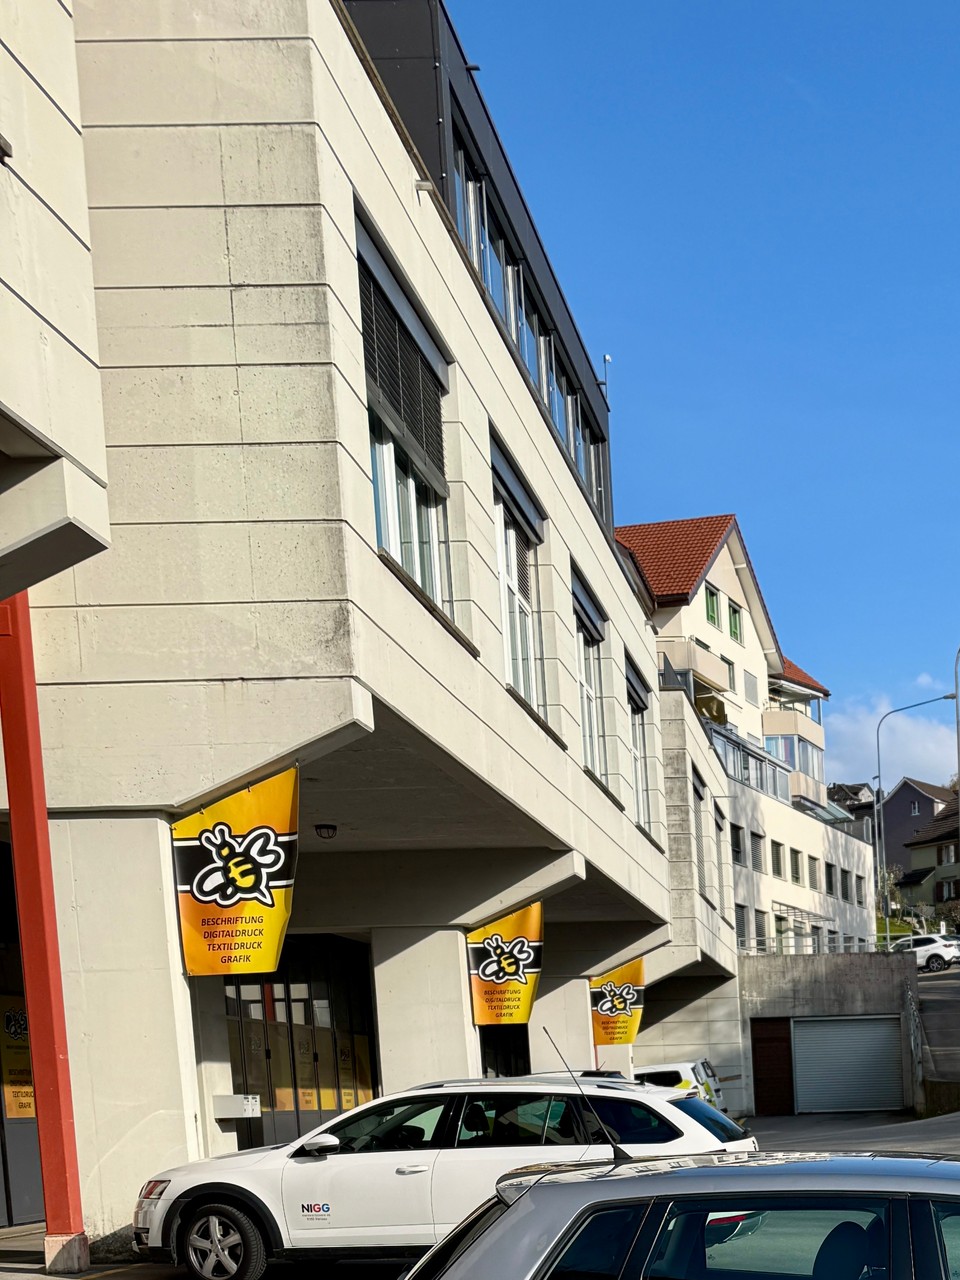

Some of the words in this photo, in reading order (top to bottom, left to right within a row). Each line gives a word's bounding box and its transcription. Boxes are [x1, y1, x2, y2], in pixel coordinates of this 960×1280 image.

[201, 915, 264, 927] BESCHRIFTUNG
[203, 928, 264, 939] DIGITALDRUCK
[207, 941, 263, 952] TEXTILDRUCK
[220, 954, 251, 964] GRAFIK
[301, 1203, 330, 1213] NIGG
